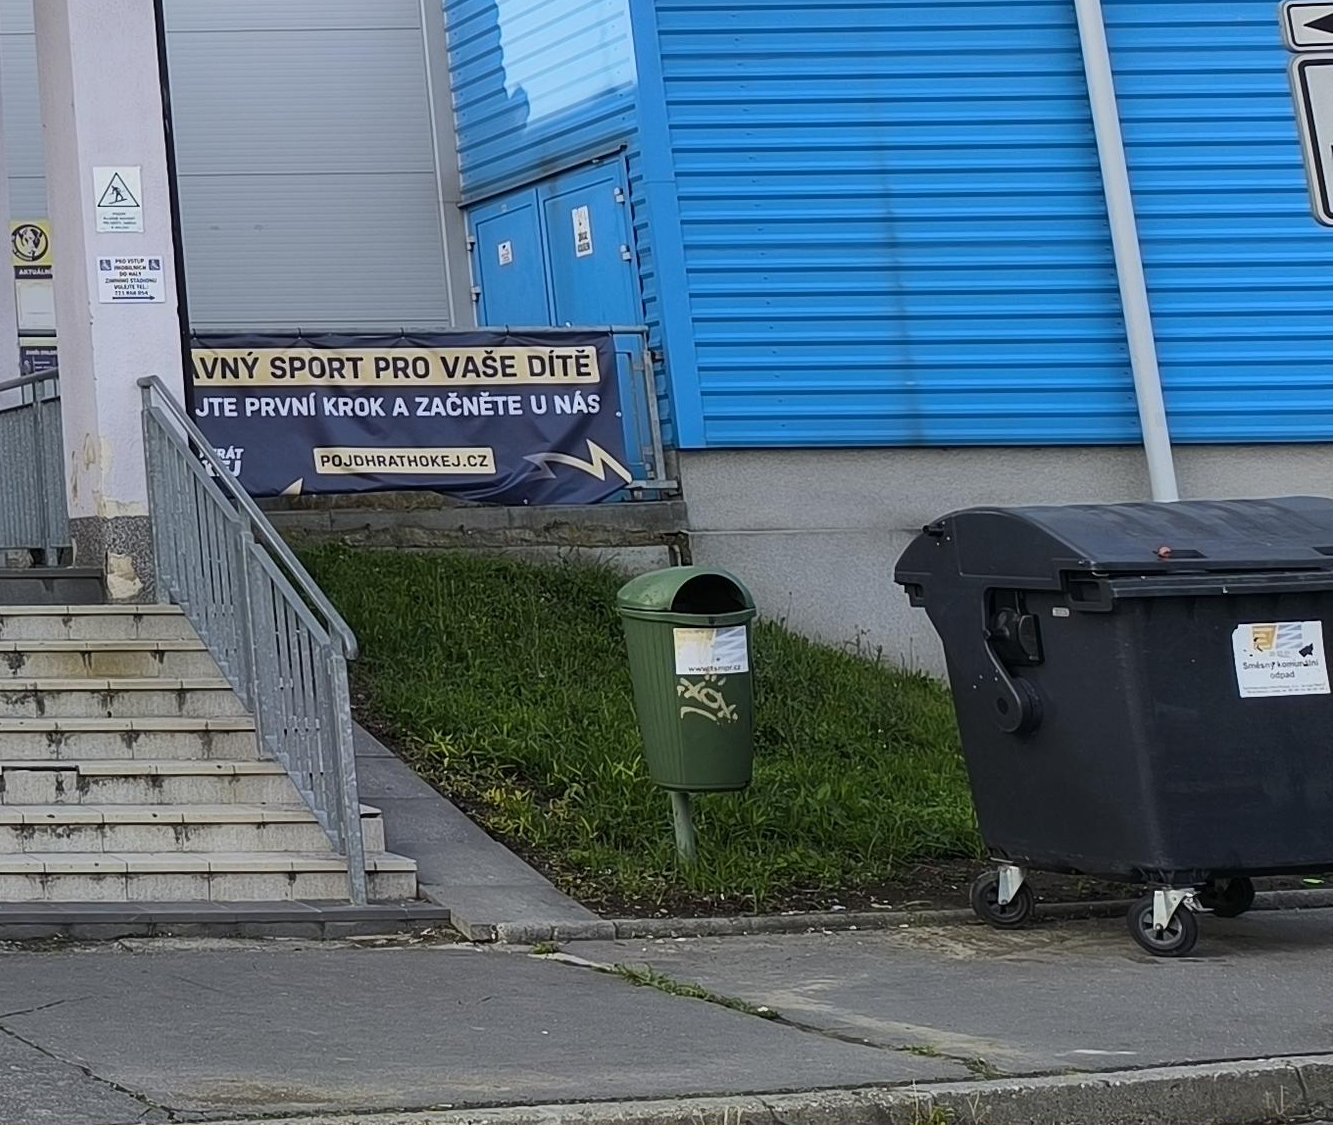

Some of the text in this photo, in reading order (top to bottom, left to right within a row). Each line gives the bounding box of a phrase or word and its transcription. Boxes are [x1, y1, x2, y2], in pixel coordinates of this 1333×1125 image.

[270, 354, 363, 379] SPORT
[374, 355, 431, 379] PRO
[440, 349, 517, 378] VAŠE
[528, 348, 593, 377] DÍTĚ
[195, 391, 600, 417] JTE PRVNÍ KROK A ZAČNĚTE U NÁS
[213, 445, 244, 459] RÁT
[321, 455, 489, 469] POJDHRATHOKEJ.CZ
